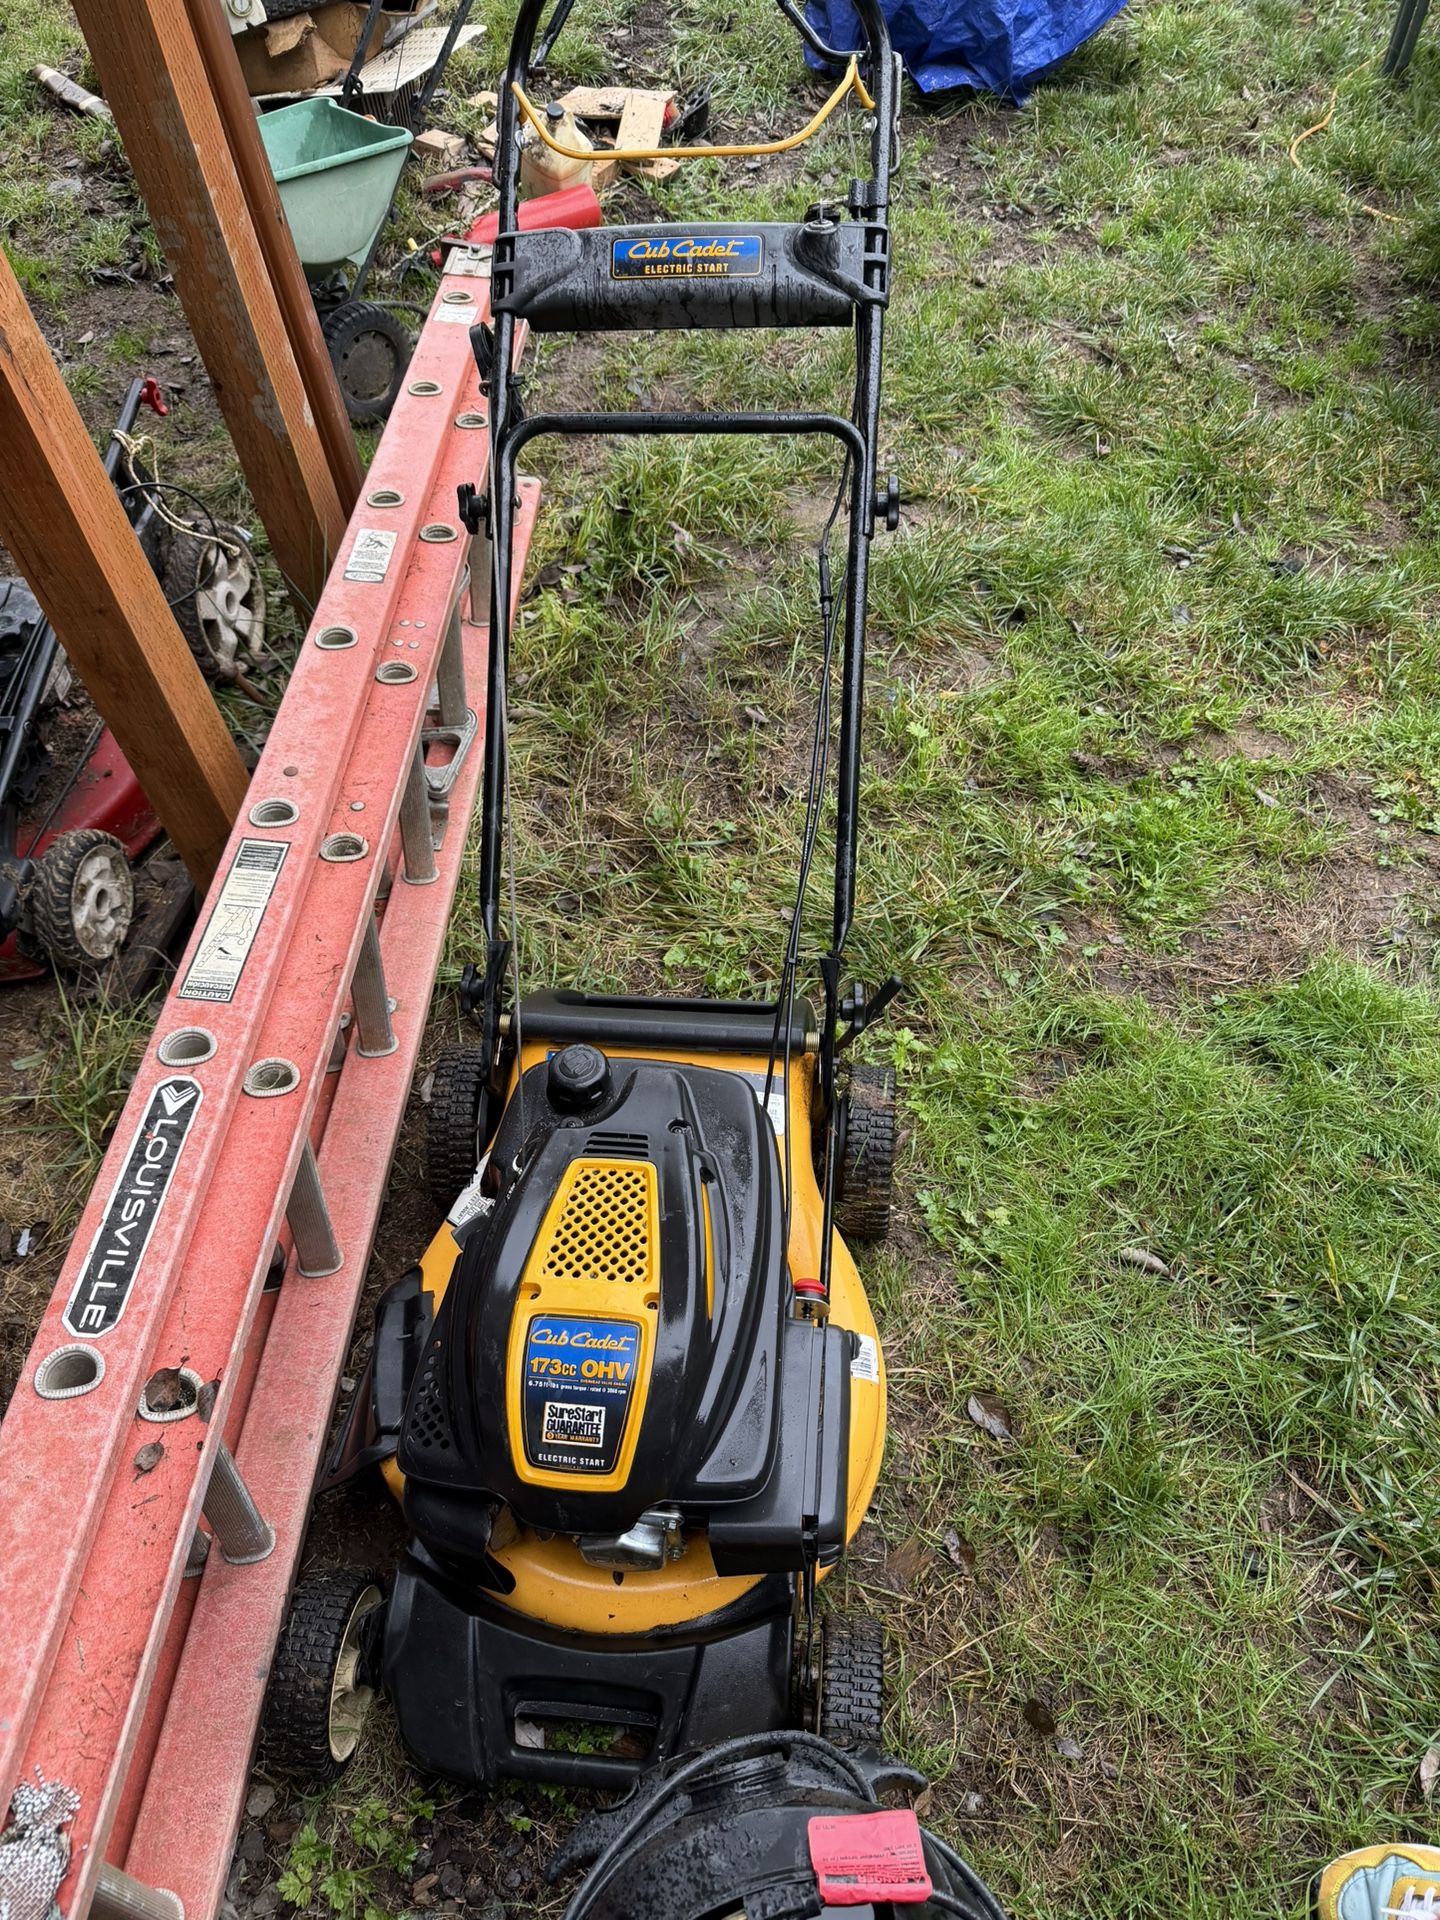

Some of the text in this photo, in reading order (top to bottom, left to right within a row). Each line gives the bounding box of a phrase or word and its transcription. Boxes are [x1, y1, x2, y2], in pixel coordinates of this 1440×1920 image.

[628, 240, 744, 258] Cub Cadet
[645, 263, 729, 274] ELECTRIC START
[183, 989, 229, 999] CAUTION
[78, 1119, 178, 1329] LOUISVILLE
[530, 1329, 635, 1351] Cub Cadet
[530, 1357, 631, 1381] 173cc OHV
[548, 1405, 603, 1423] SureStart
[546, 1419, 601, 1435] GUARANTEE
[570, 1435, 600, 1443] WARRANTY
[538, 1453, 577, 1464] ELECTRIC
[579, 1458, 605, 1467] START
